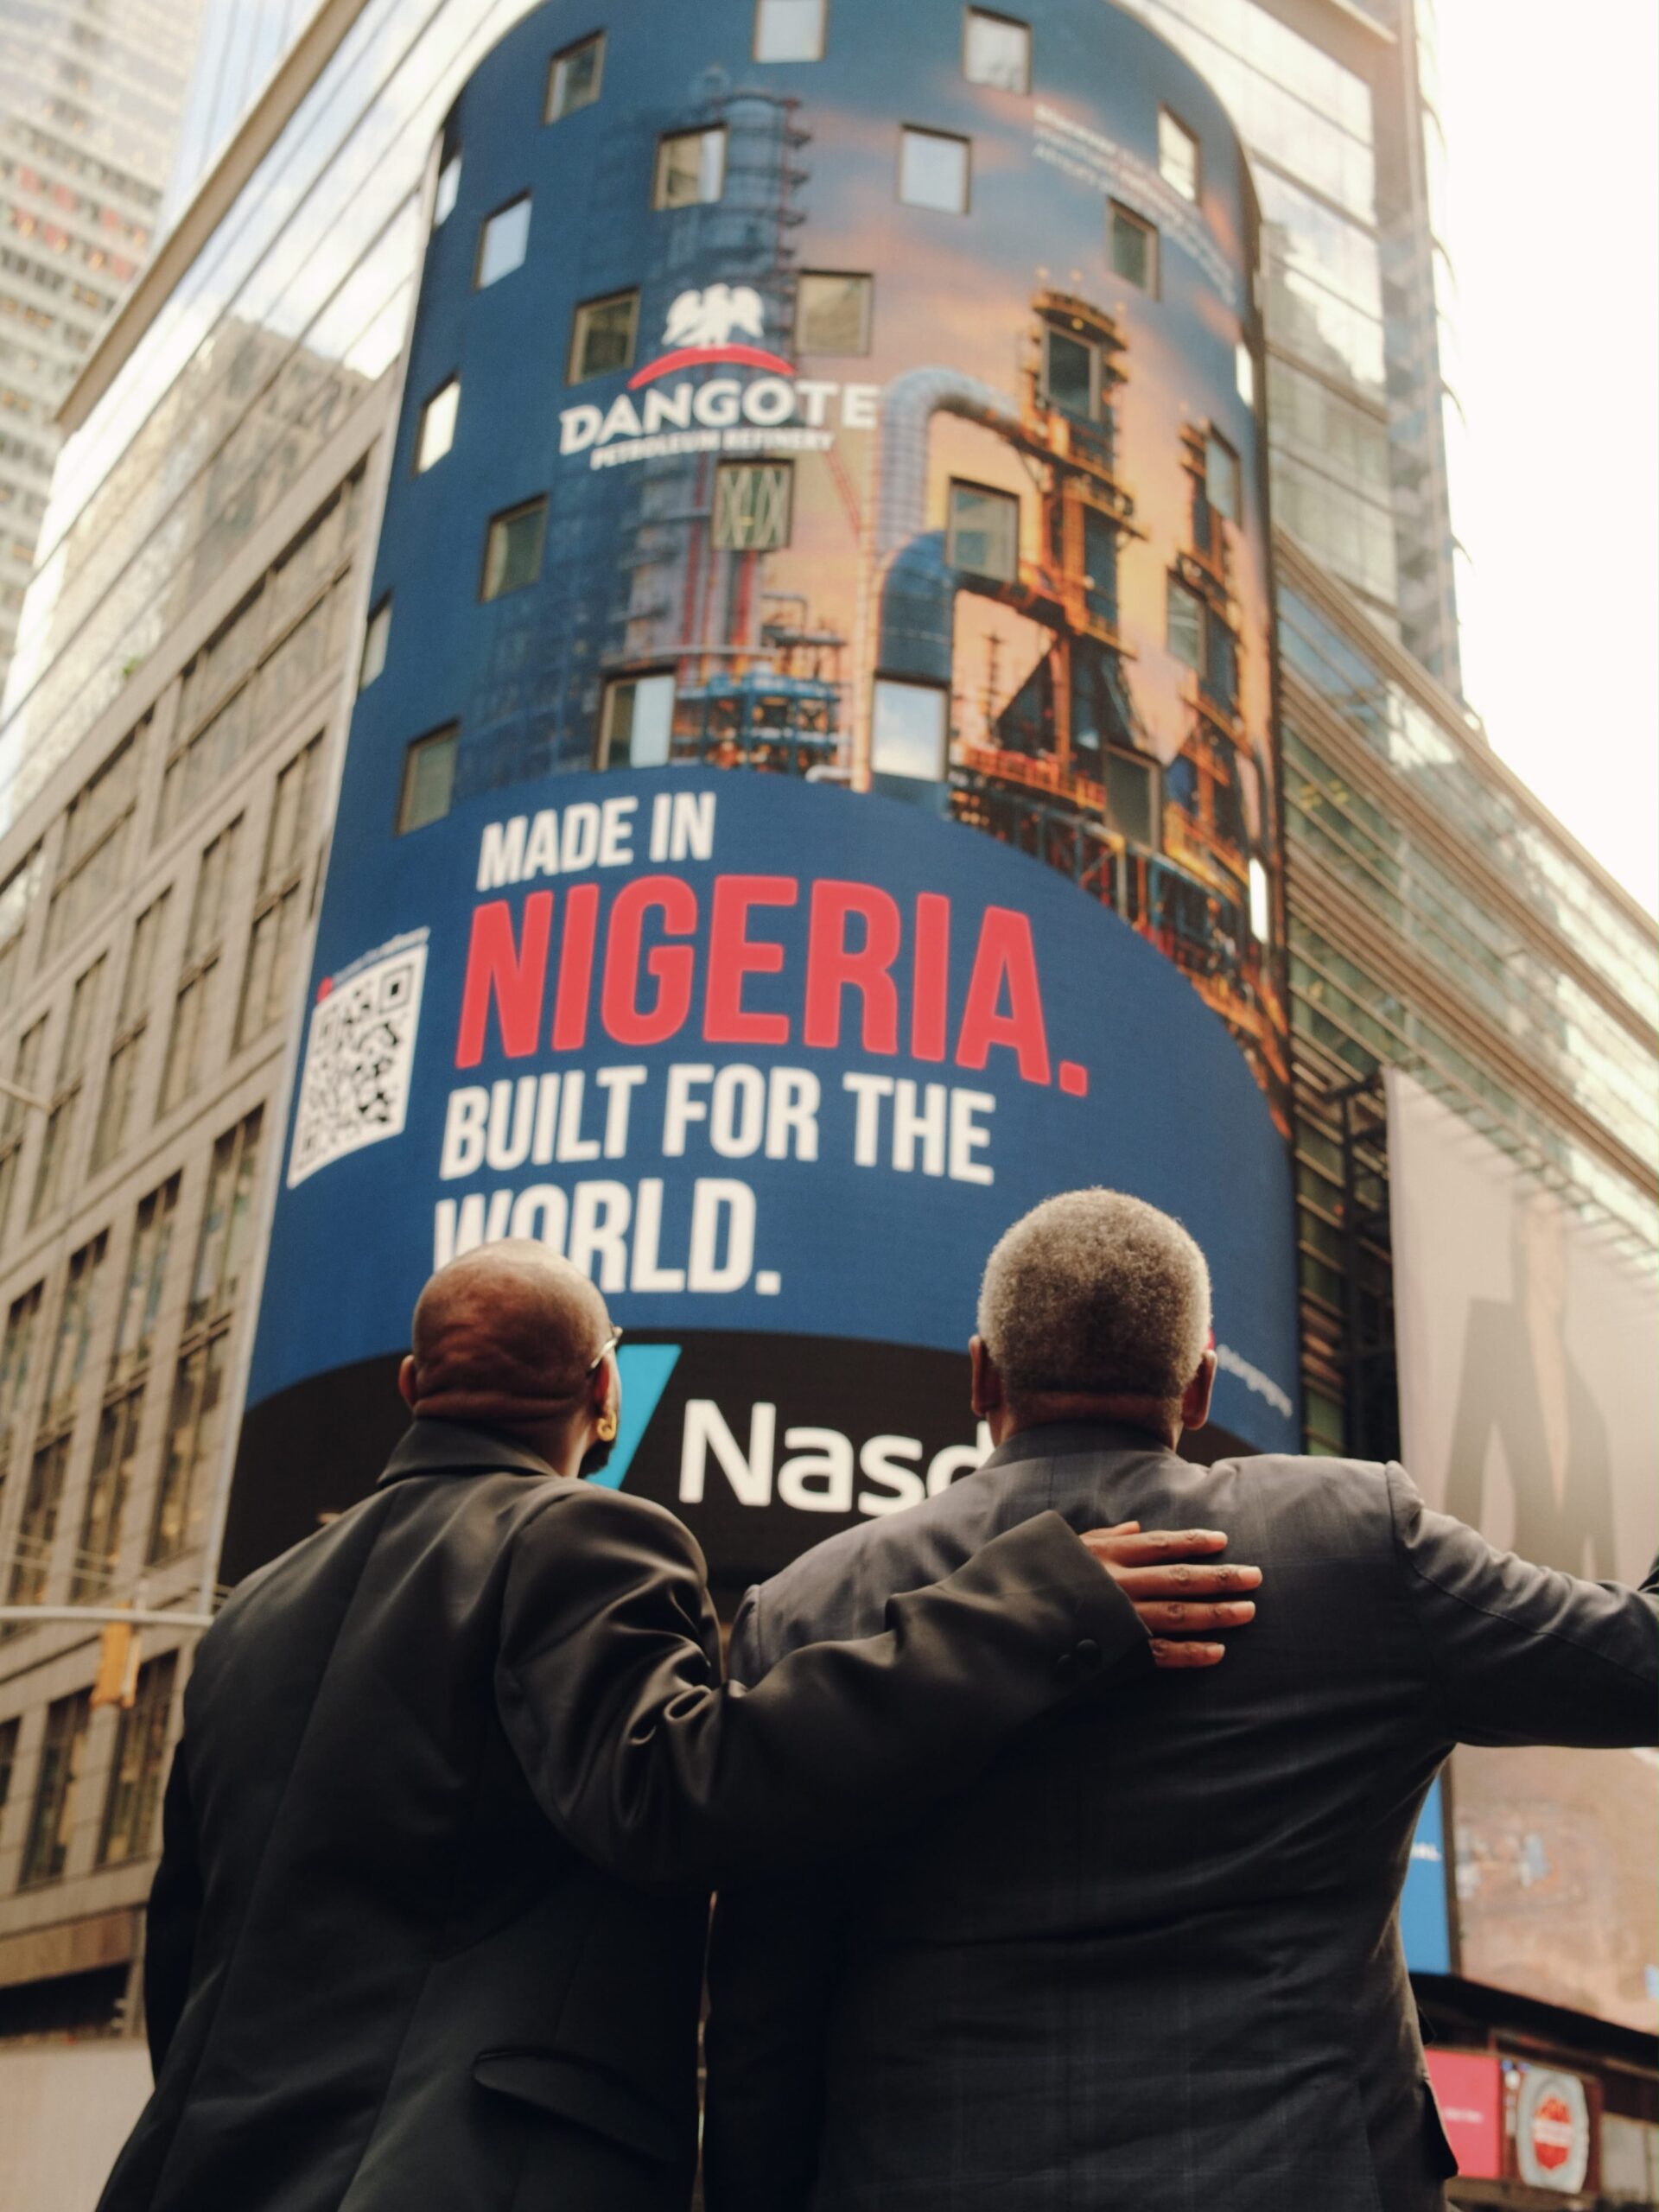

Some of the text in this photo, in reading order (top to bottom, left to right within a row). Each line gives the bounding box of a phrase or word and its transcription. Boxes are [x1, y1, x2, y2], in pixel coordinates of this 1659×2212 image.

[558, 377, 881, 456] DANGOTE
[476, 791, 716, 892] MADE IN
[454, 874, 1089, 1098] NIGERIA.
[439, 1063, 996, 1186] BUILT FOR THE
